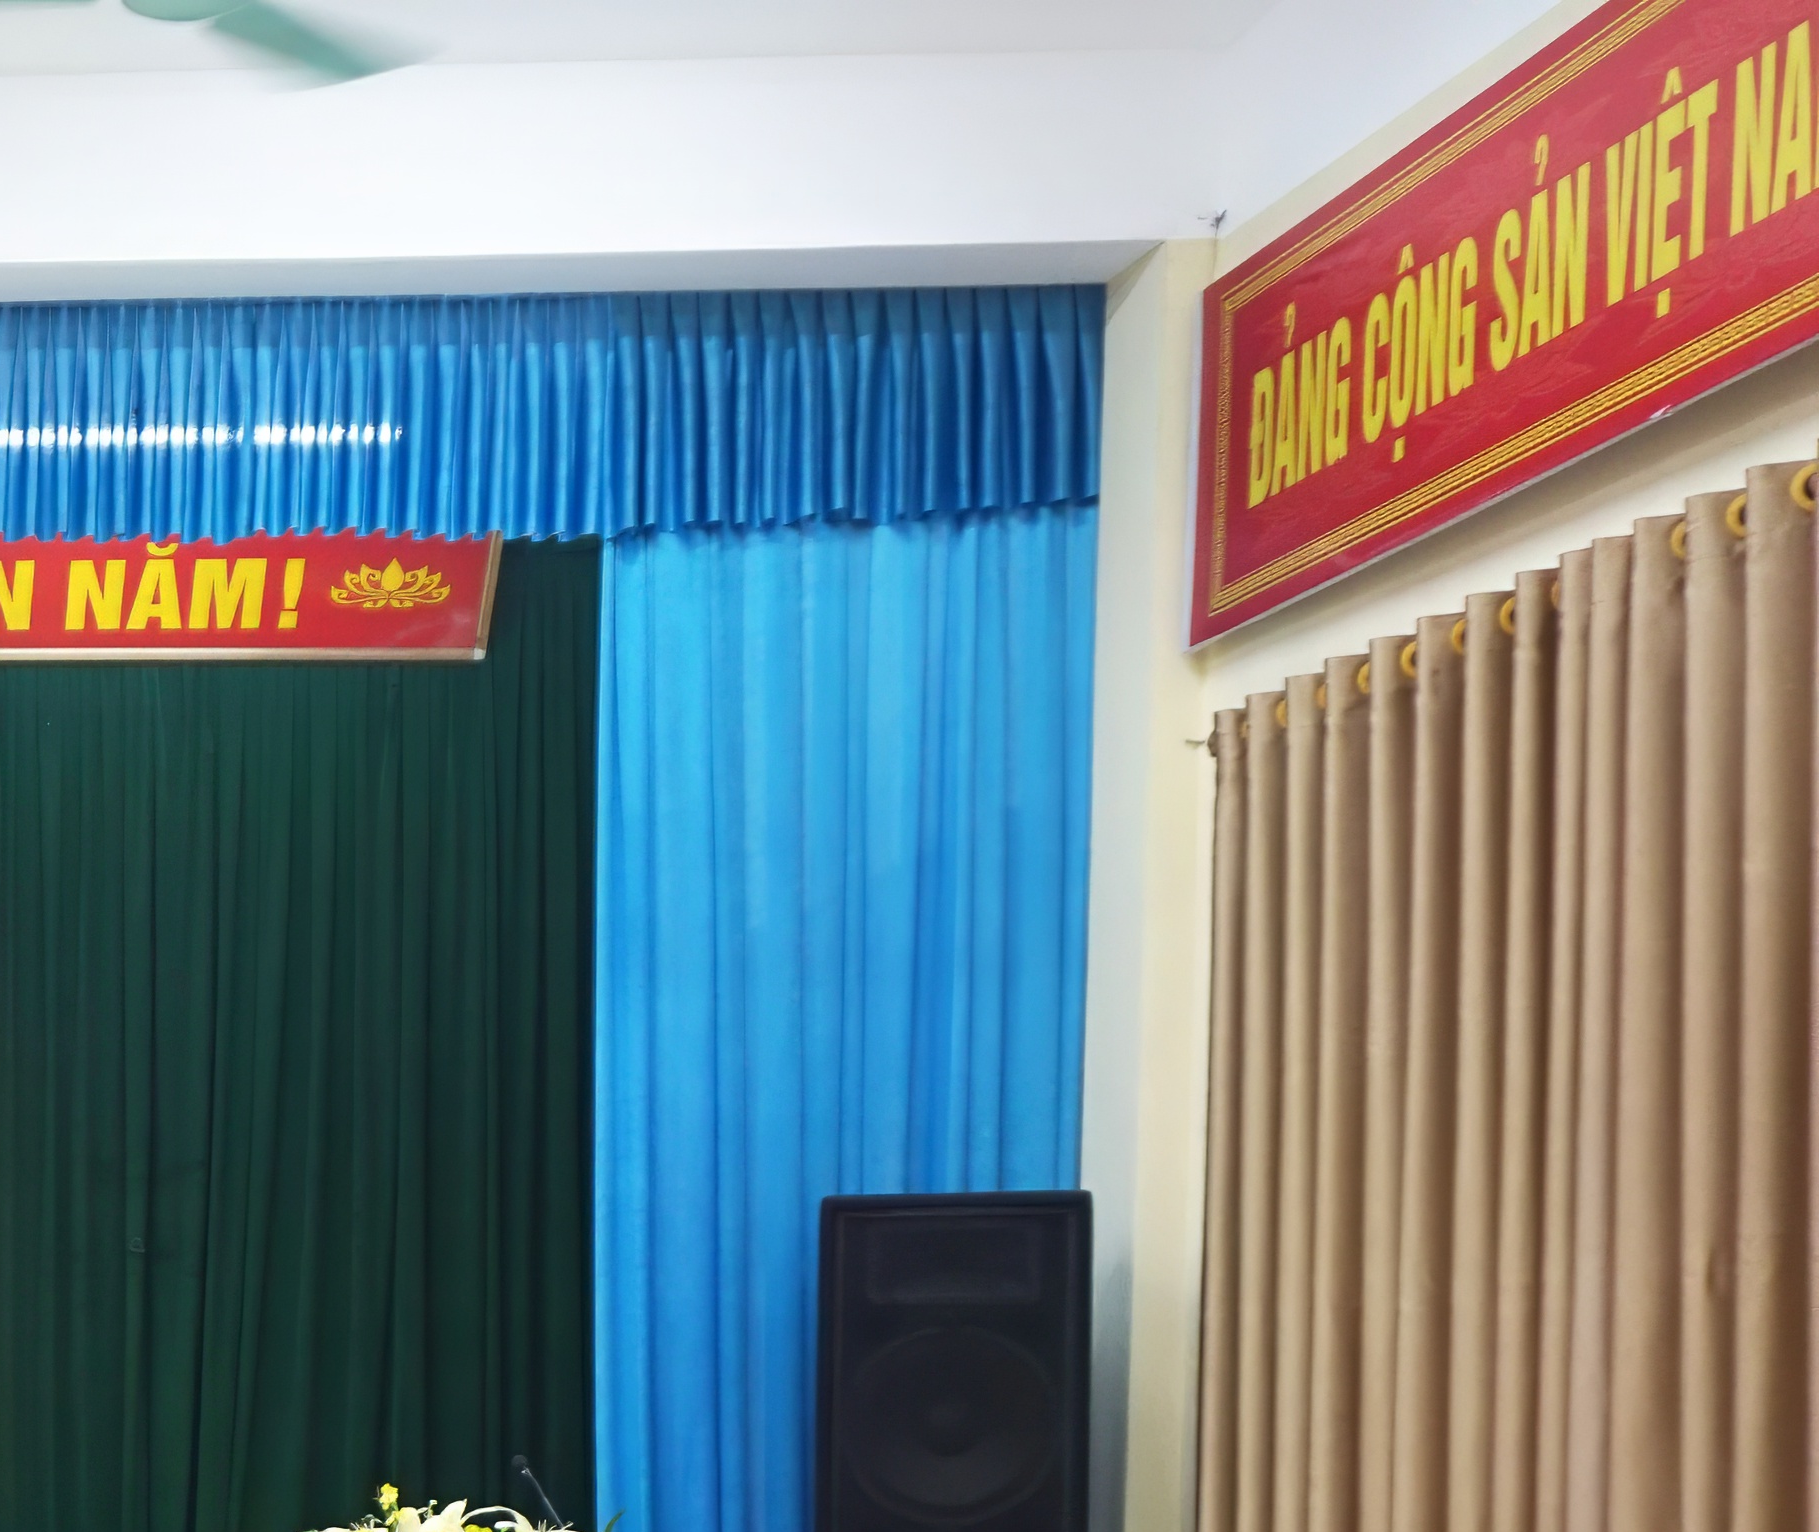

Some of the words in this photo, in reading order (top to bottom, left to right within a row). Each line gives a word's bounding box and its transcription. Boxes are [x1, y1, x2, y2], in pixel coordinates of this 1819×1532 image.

[1247, 302, 1352, 509] ĐẢNG
[1362, 236, 1478, 462] CỘNG
[1489, 134, 1591, 372] SẢN
[1605, 66, 1719, 318] VIỆT
[1730, 20, 1819, 237] NA
